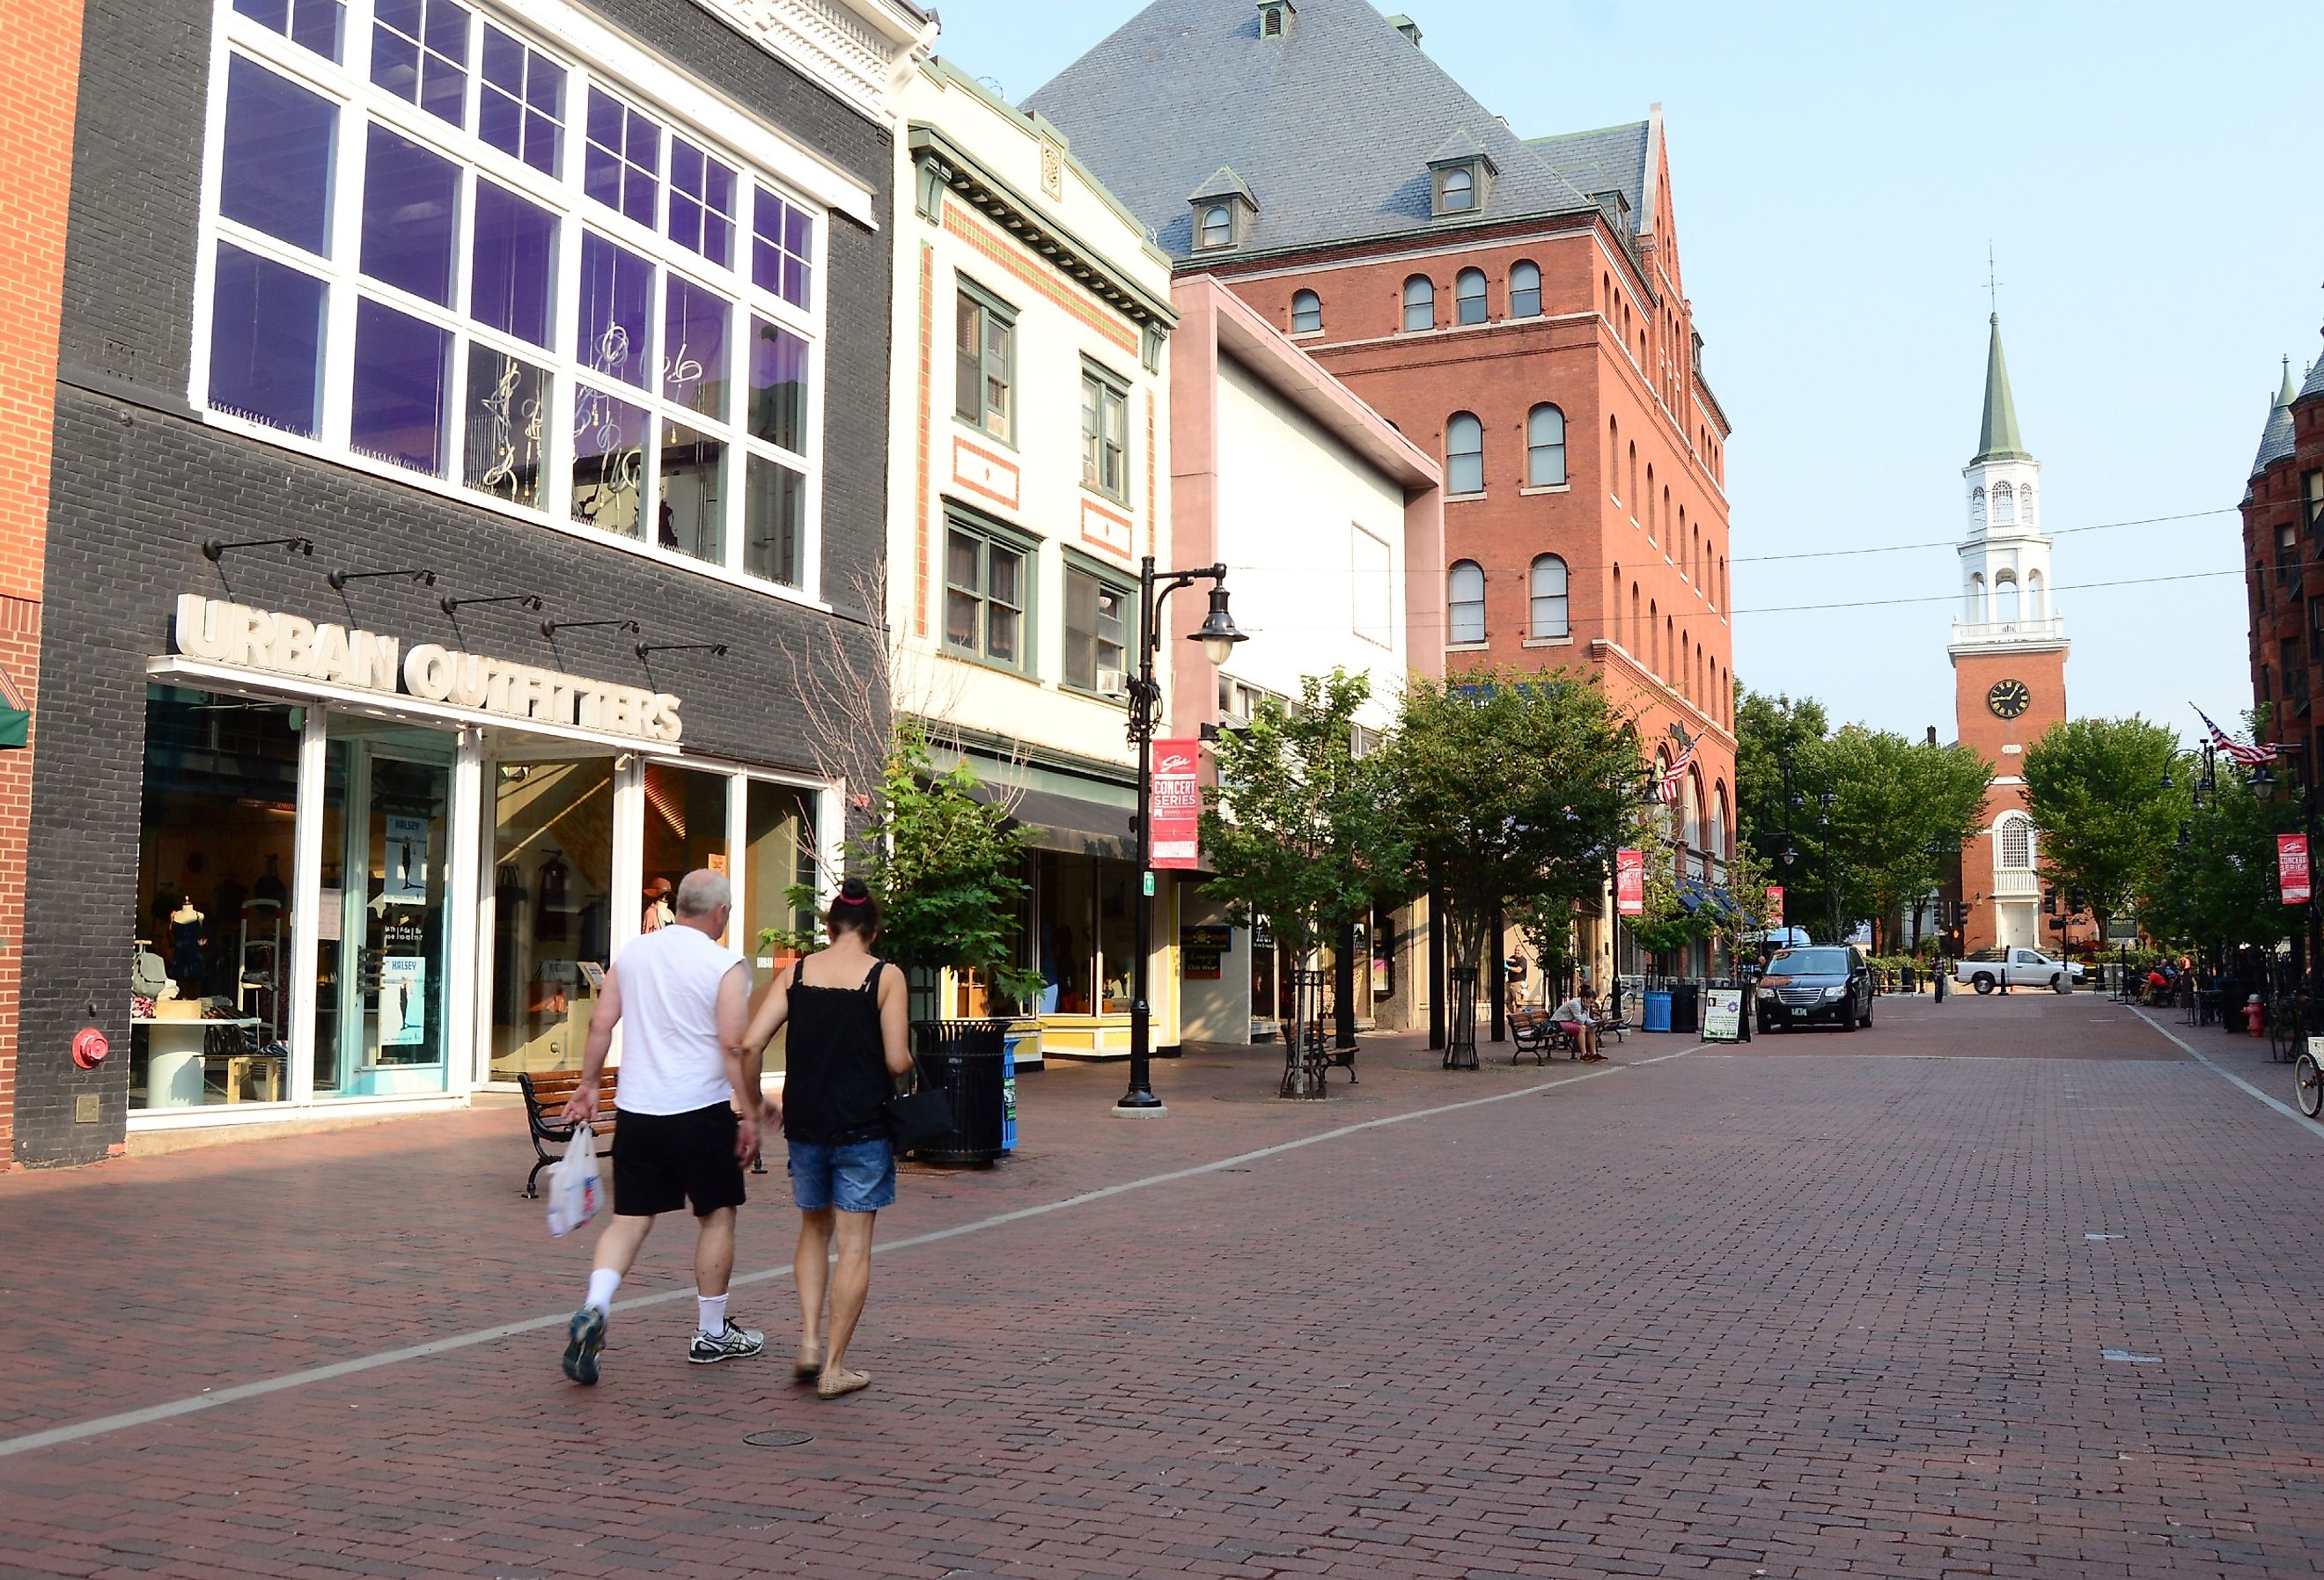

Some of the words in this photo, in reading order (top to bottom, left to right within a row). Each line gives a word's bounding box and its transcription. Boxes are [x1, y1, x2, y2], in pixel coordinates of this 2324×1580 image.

[175, 593, 399, 693] URBAN
[404, 643, 682, 741] OUTFITTERS
[1154, 780, 1195, 795] CONCERT
[1154, 795, 1195, 805] SERIES
[394, 819, 420, 830] HALSEY
[392, 960, 416, 971] HALSEY
